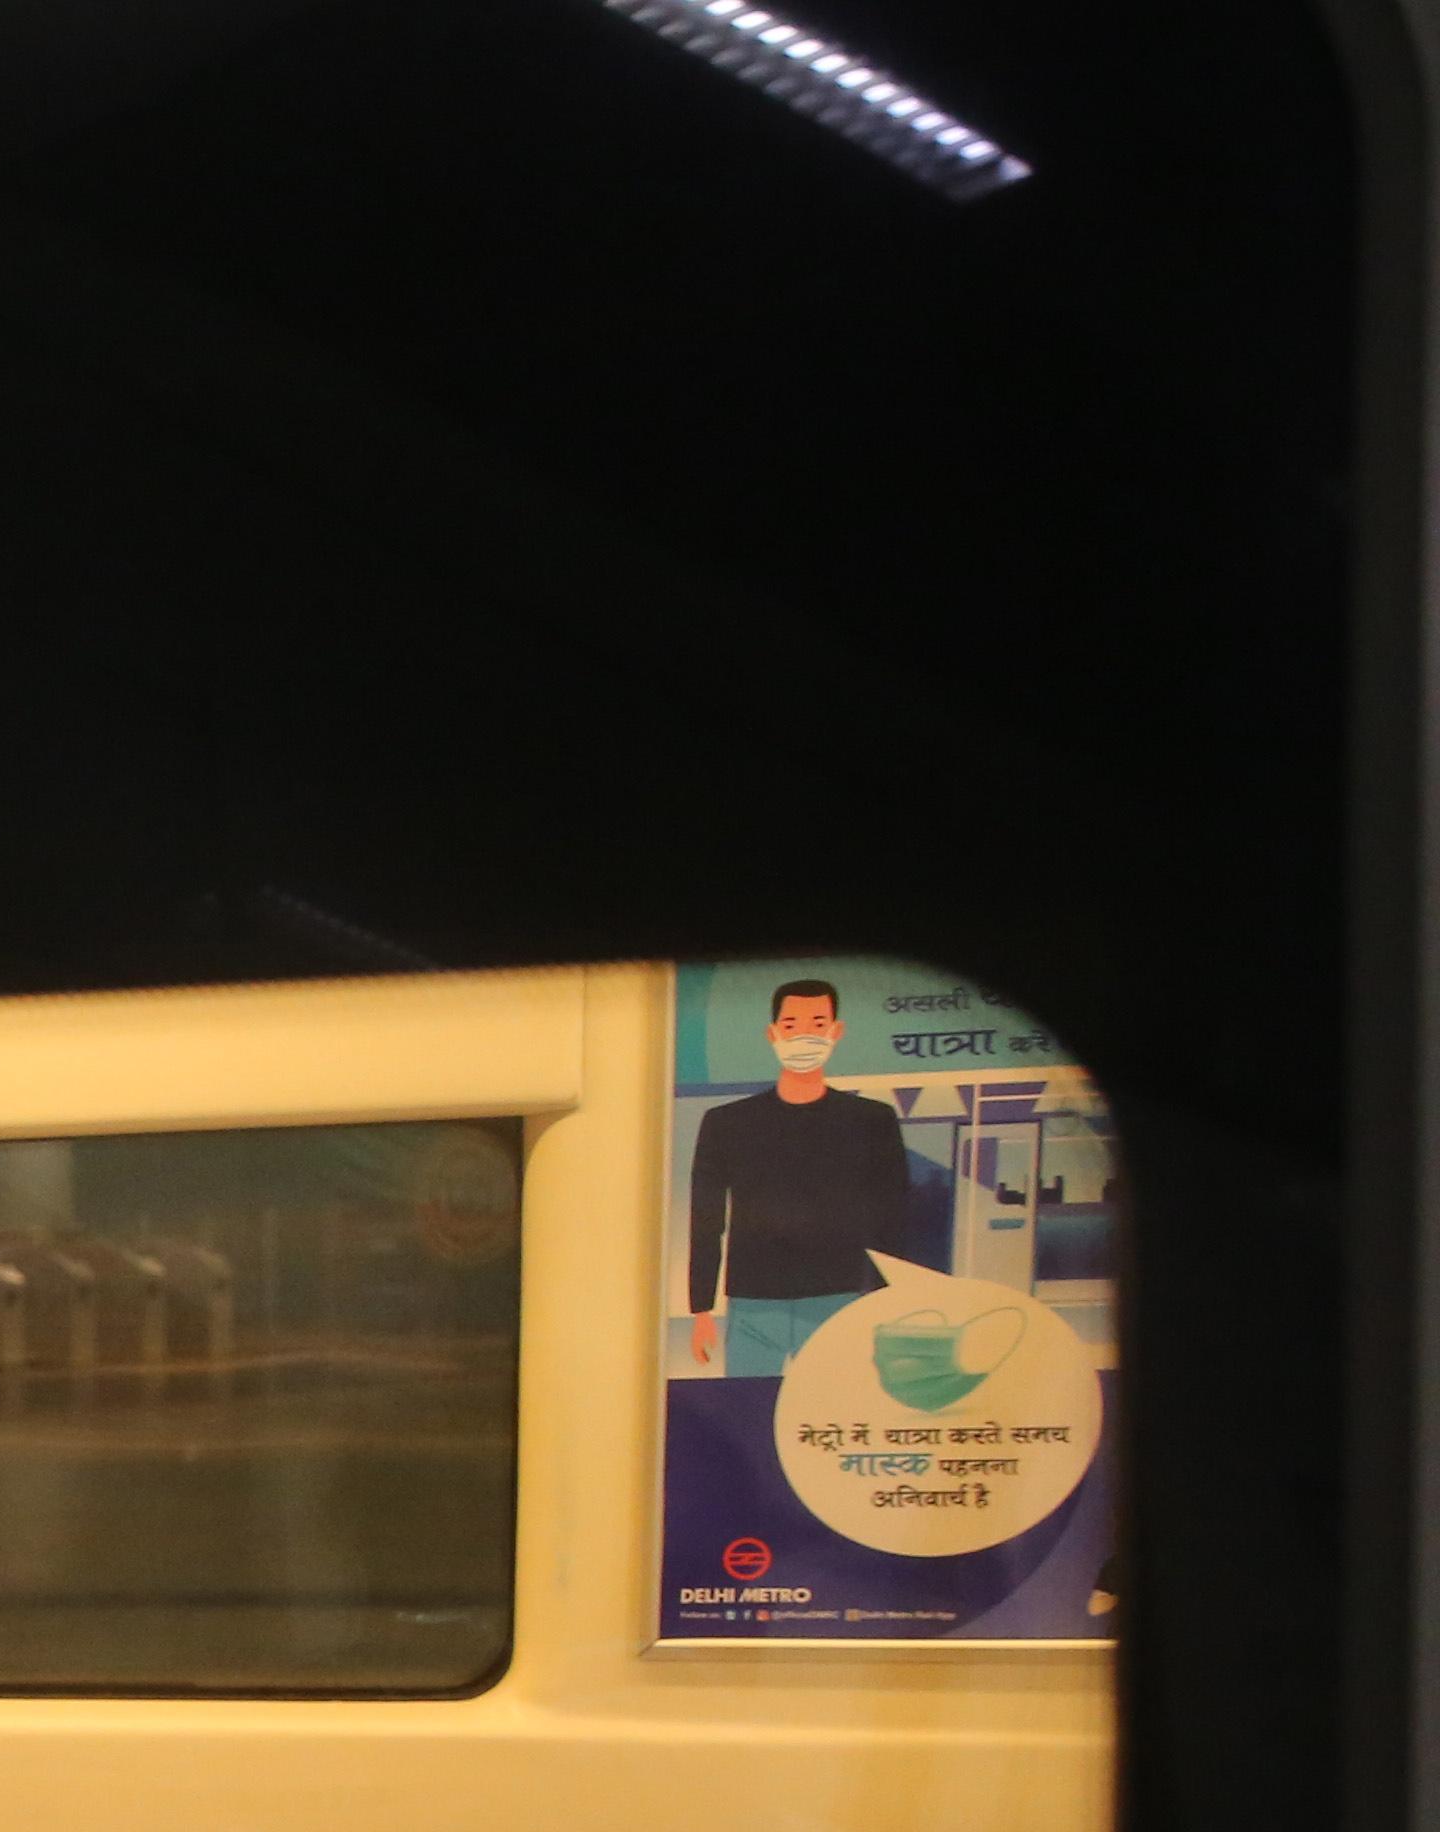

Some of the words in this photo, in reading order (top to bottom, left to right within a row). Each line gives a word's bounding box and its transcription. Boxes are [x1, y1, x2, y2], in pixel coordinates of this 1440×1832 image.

[885, 987, 971, 1015] असली
[892, 1029, 998, 1059] यात्रा
[797, 1423, 845, 1453] मेट्रो
[850, 1423, 871, 1445] में
[885, 1427, 943, 1446] यात्रा
[947, 1421, 1003, 1445] करते
[1010, 1426, 1071, 1444] समय
[838, 1453, 935, 1477] मास्क
[939, 1457, 1020, 1478] पहनना
[871, 1484, 971, 1509] अनिवार्य
[973, 1485, 992, 1509] है
[679, 1587, 737, 1604] DELHI
[738, 1587, 813, 1604] METRO
